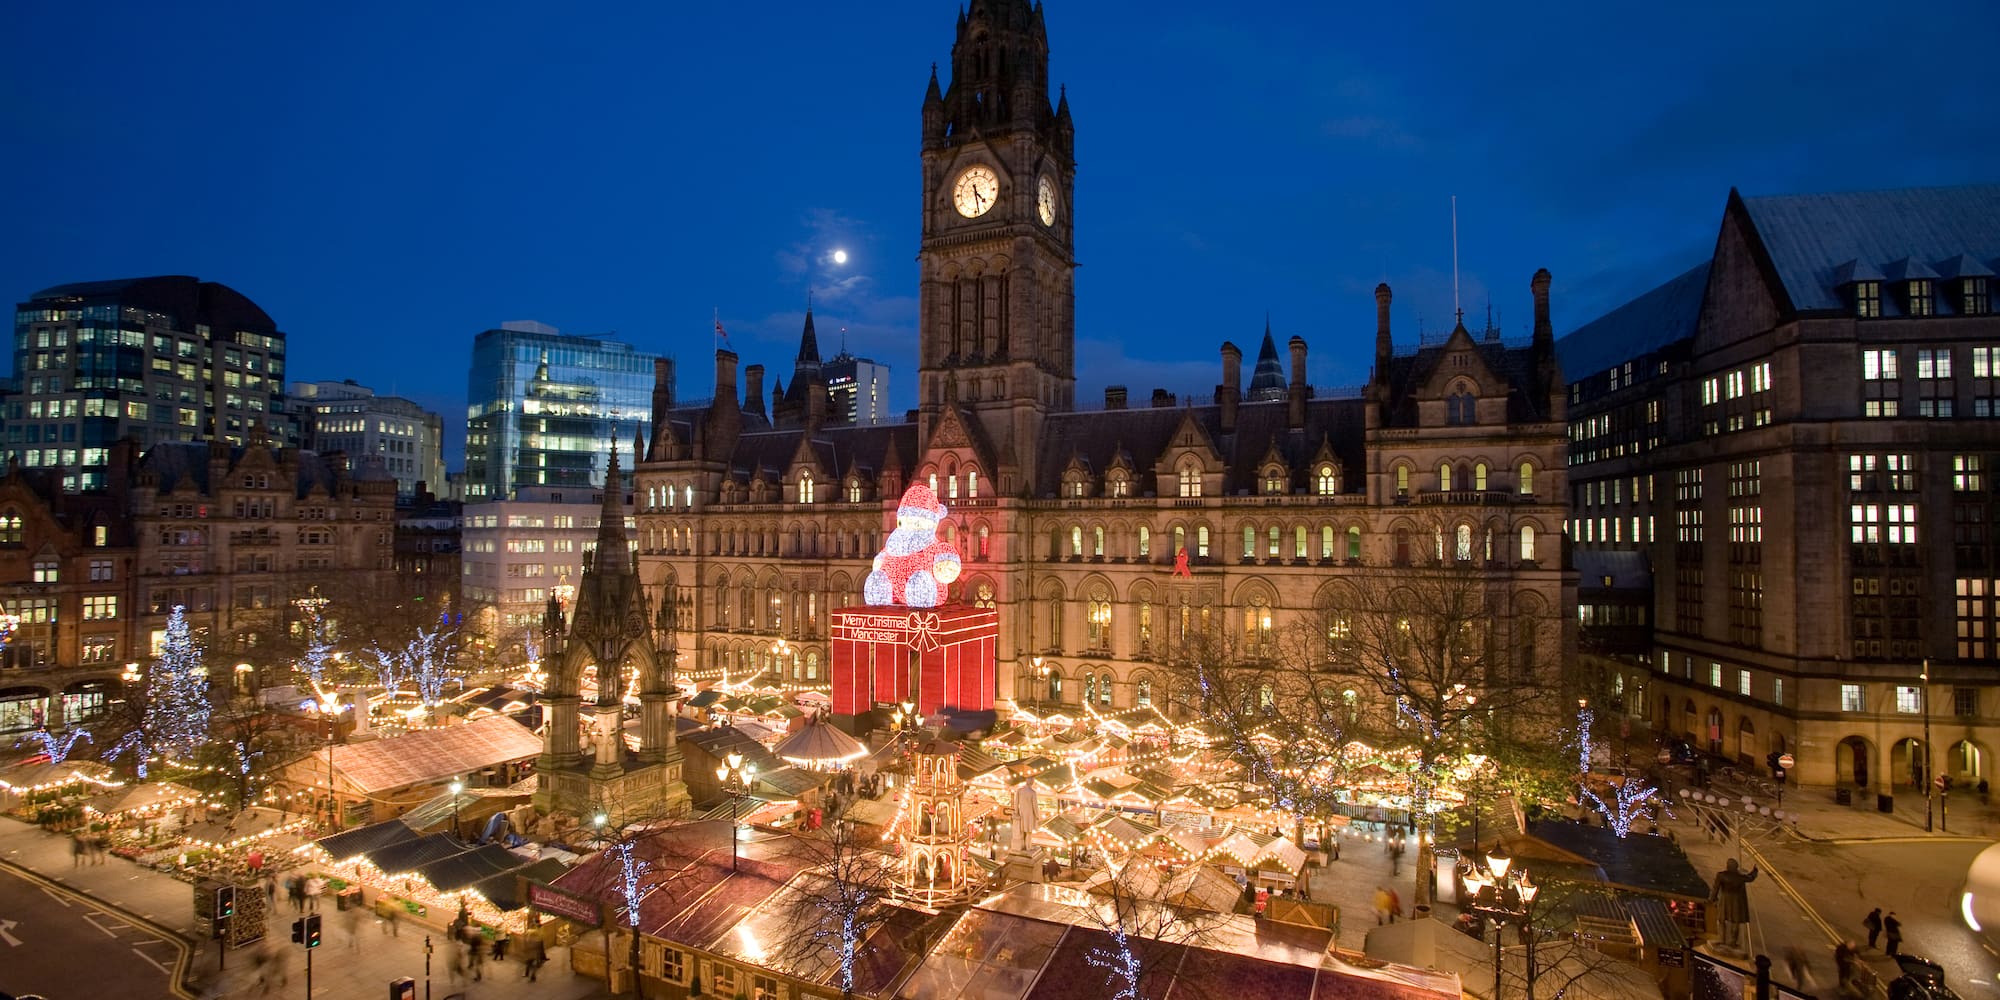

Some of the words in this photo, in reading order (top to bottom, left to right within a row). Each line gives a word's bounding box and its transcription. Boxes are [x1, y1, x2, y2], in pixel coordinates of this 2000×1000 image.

[844, 615, 866, 628] Merry
[868, 616, 907, 628] Christmas
[851, 628, 899, 641] Manchester
